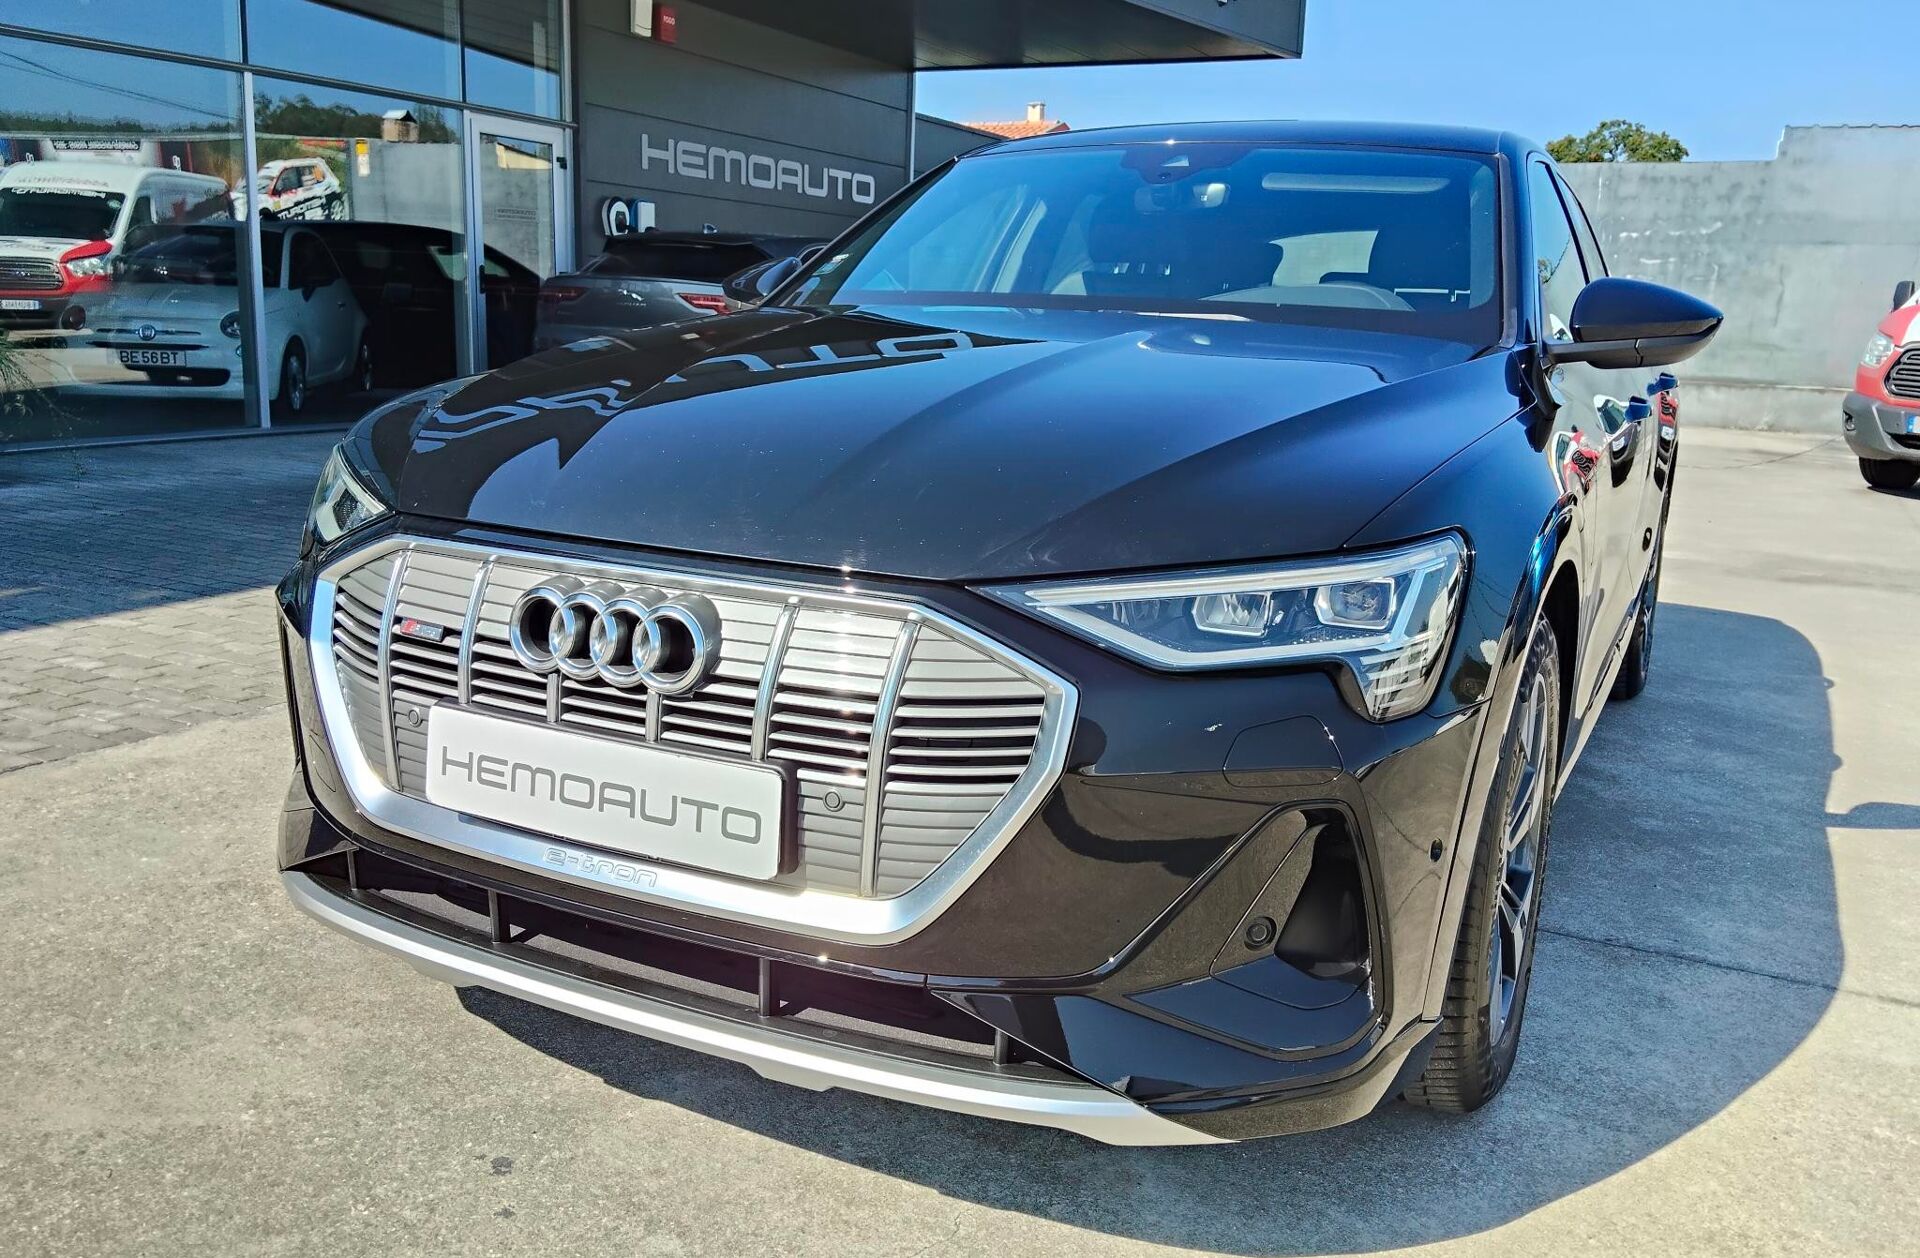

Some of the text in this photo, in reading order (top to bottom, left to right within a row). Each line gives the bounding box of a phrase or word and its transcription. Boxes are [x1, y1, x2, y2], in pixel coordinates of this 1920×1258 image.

[640, 133, 877, 205] HEMOAUTO
[441, 745, 762, 846] HEMOAUTO
[543, 847, 658, 888] e-tron
